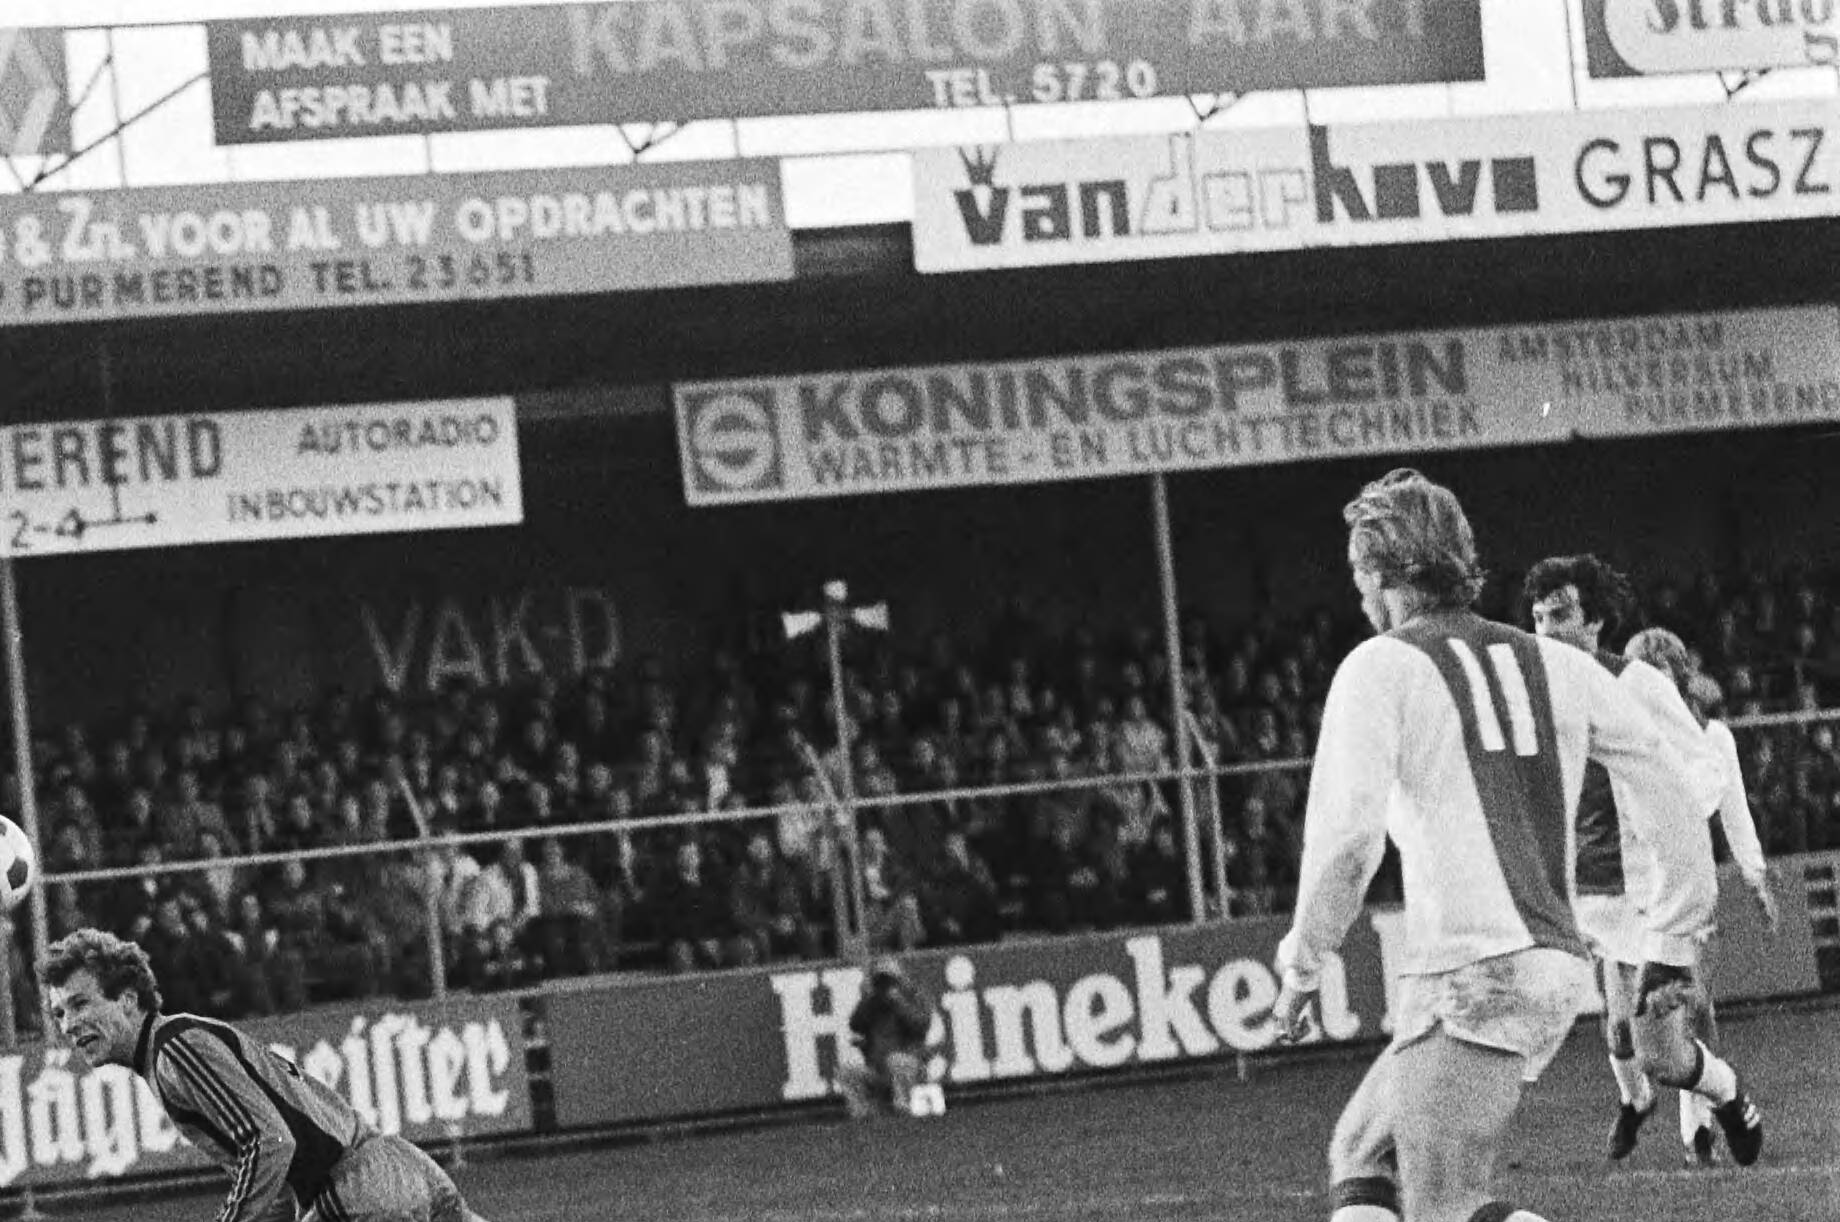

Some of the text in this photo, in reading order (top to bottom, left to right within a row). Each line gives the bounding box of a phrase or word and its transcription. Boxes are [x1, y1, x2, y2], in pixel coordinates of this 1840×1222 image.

[242, 24, 453, 71] MAAK EEN
[249, 77, 551, 131] AFSPRAAK MET
[924, 59, 1157, 105] TEL. 5720
[1575, 128, 1830, 208] GRASZ
[15, 215, 51, 267] &
[140, 206, 272, 258] VOOR
[288, 205, 340, 249] AL
[358, 203, 434, 246] UW
[459, 183, 769, 243] OPDRACHTEN
[21, 264, 282, 310] PURMEREND
[310, 260, 391, 294] TEL.
[798, 339, 1465, 442] KONINGSPLEIN
[298, 415, 498, 454] AUTORADIO
[228, 479, 502, 521] INBOUWSTATION
[1447, 638, 1539, 757] 11
